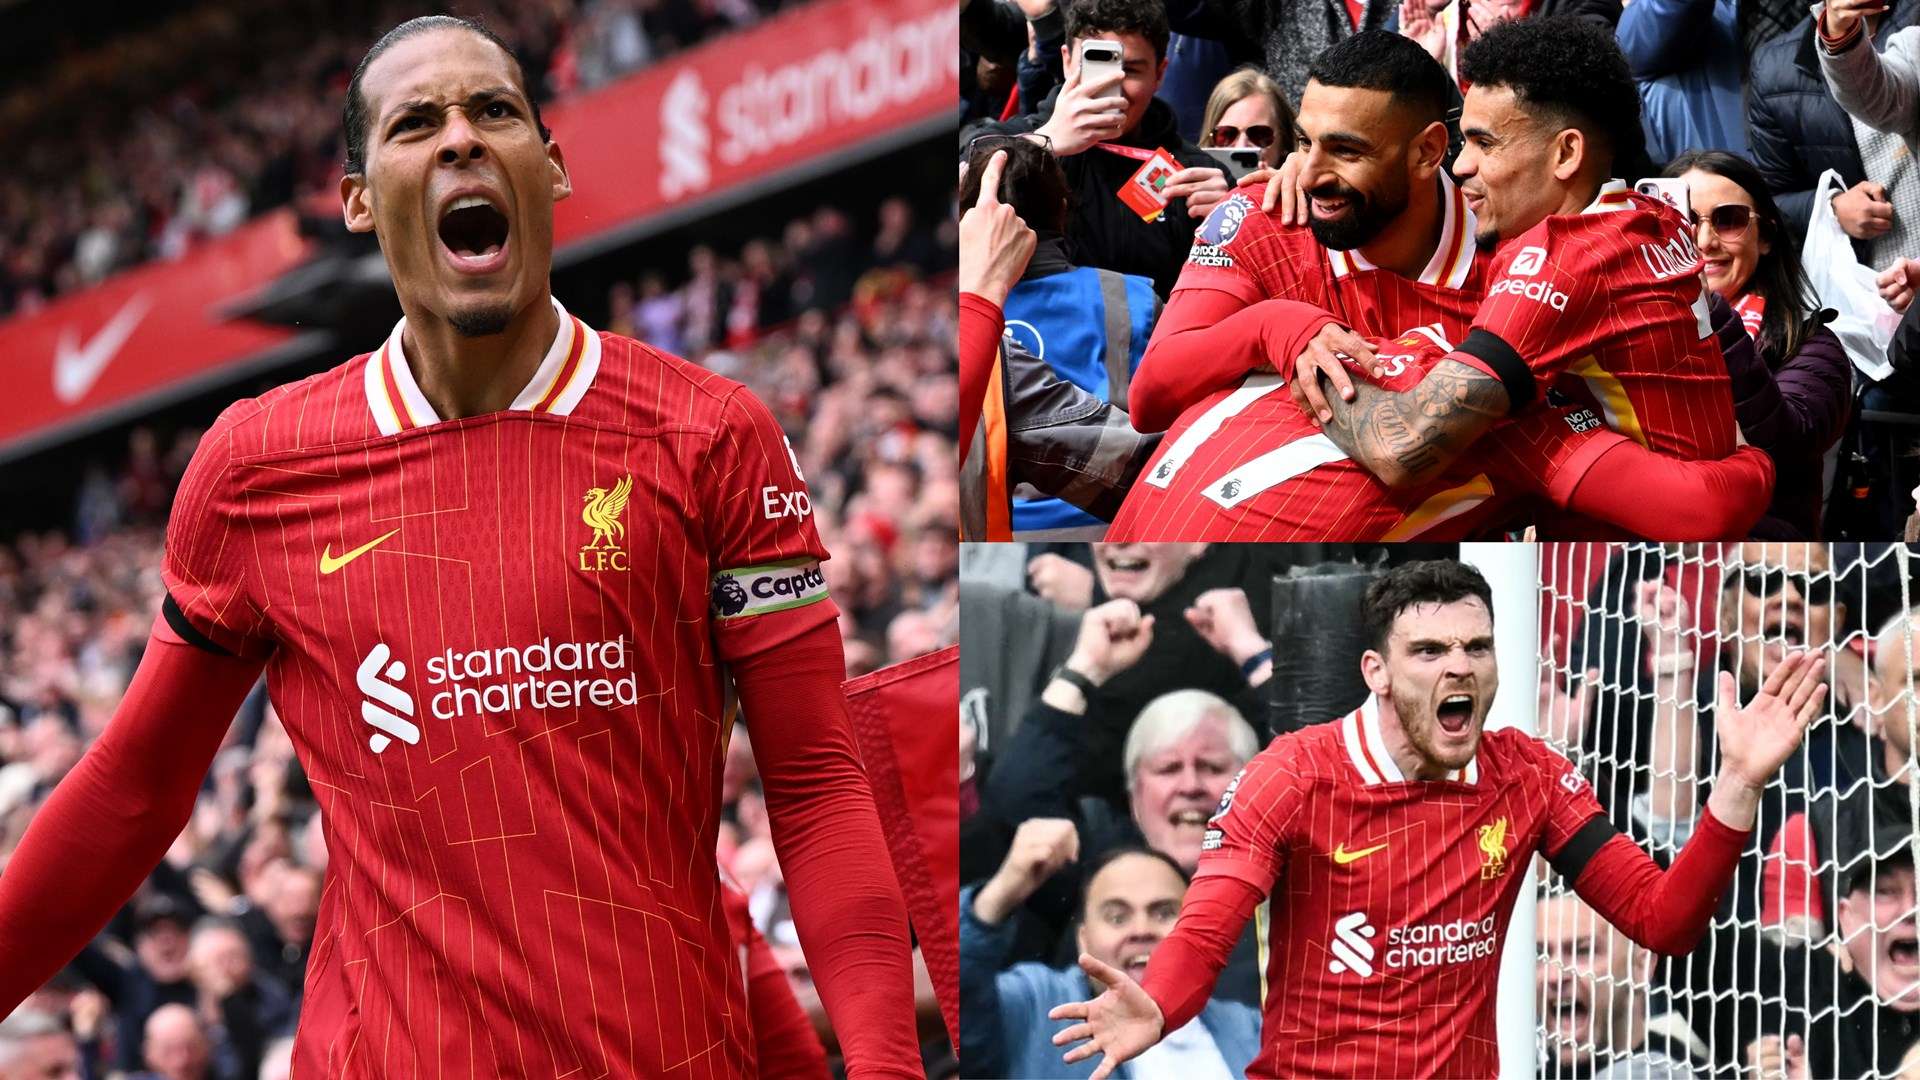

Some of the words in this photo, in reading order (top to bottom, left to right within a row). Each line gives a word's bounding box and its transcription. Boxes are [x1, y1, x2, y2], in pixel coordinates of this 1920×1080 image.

[762, 486, 811, 522] Exp
[579, 551, 631, 571] L.F.C.
[427, 634, 625, 684] standard
[431, 672, 638, 720] chartered
[1388, 912, 1496, 945] standard
[1386, 931, 1497, 968] chartered
